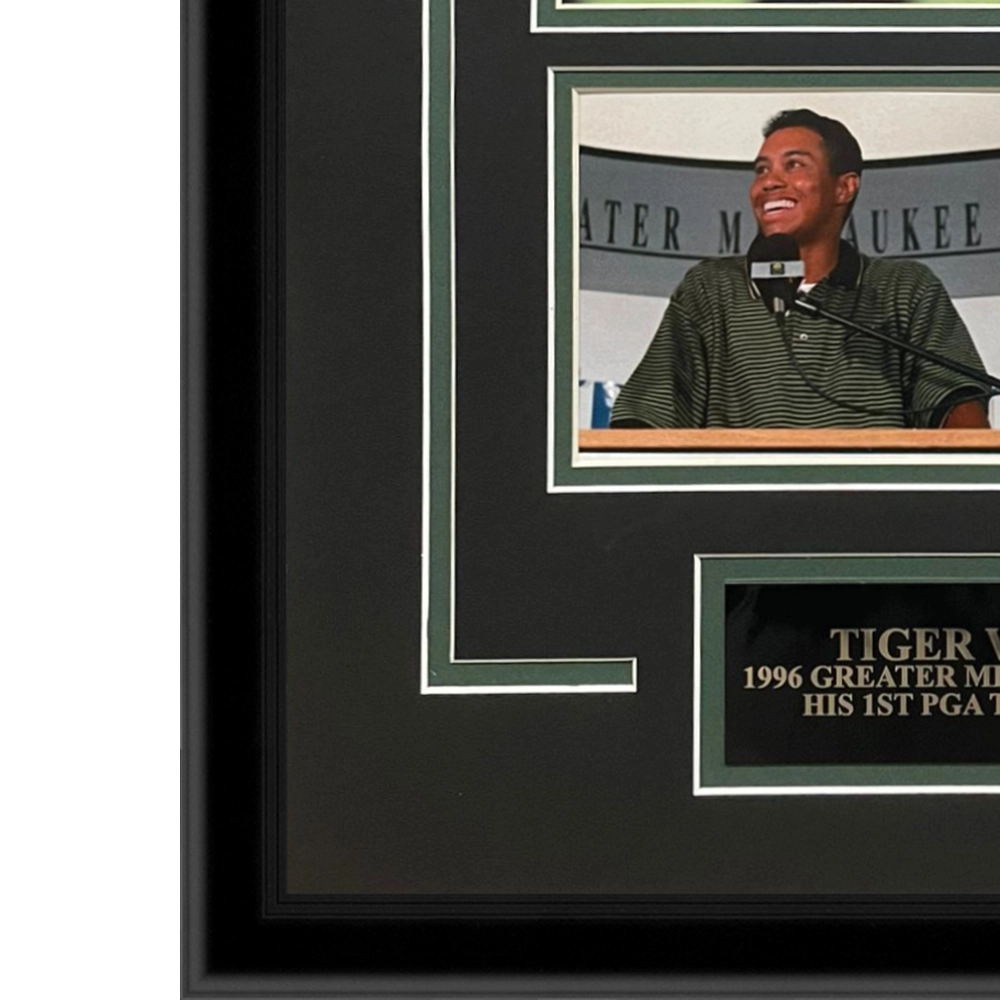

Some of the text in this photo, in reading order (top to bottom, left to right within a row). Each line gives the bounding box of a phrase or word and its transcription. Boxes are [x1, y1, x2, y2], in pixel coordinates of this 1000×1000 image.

[830, 628, 975, 662] TIGER
[743, 665, 802, 689] 1996
[810, 665, 958, 689] GREATER
[802, 693, 854, 717] HIS
[863, 693, 915, 717] 1ST
[921, 693, 983, 717] PGA
